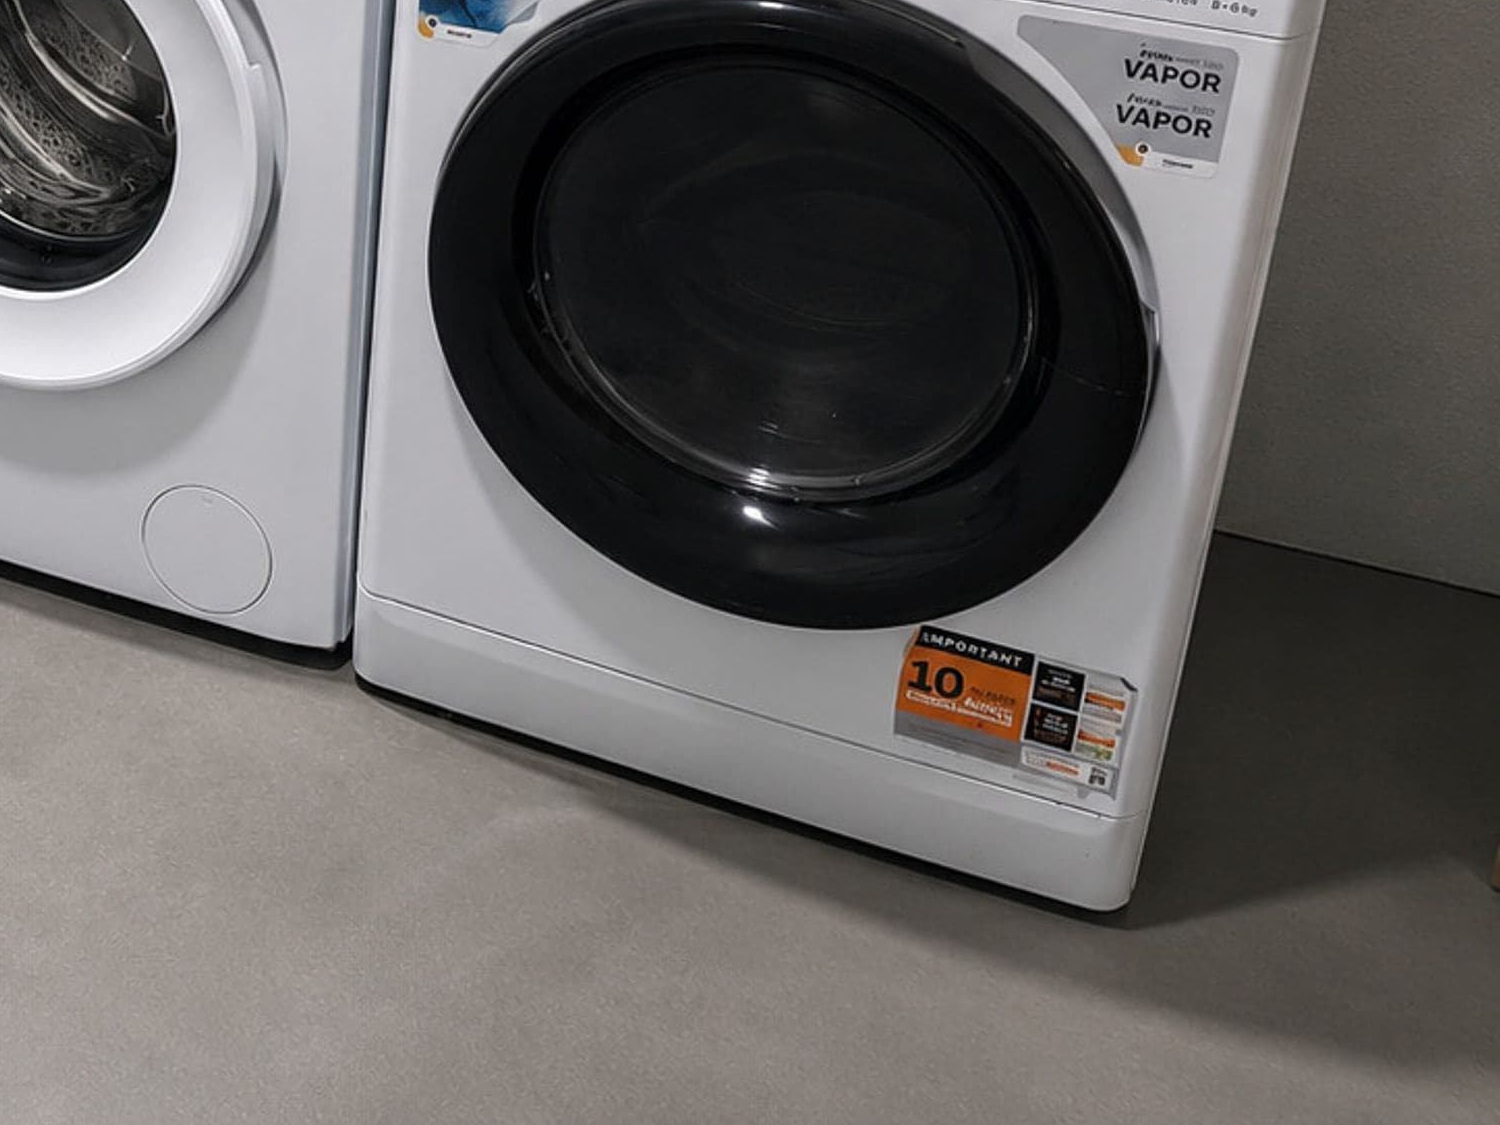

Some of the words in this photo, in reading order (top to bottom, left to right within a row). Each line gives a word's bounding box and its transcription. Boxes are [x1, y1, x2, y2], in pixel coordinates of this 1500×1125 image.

[1124, 58, 1222, 94] VAPOR
[1116, 103, 1212, 138] VAPOR
[922, 632, 1023, 667] IMPORTANT
[907, 660, 965, 700] 10
